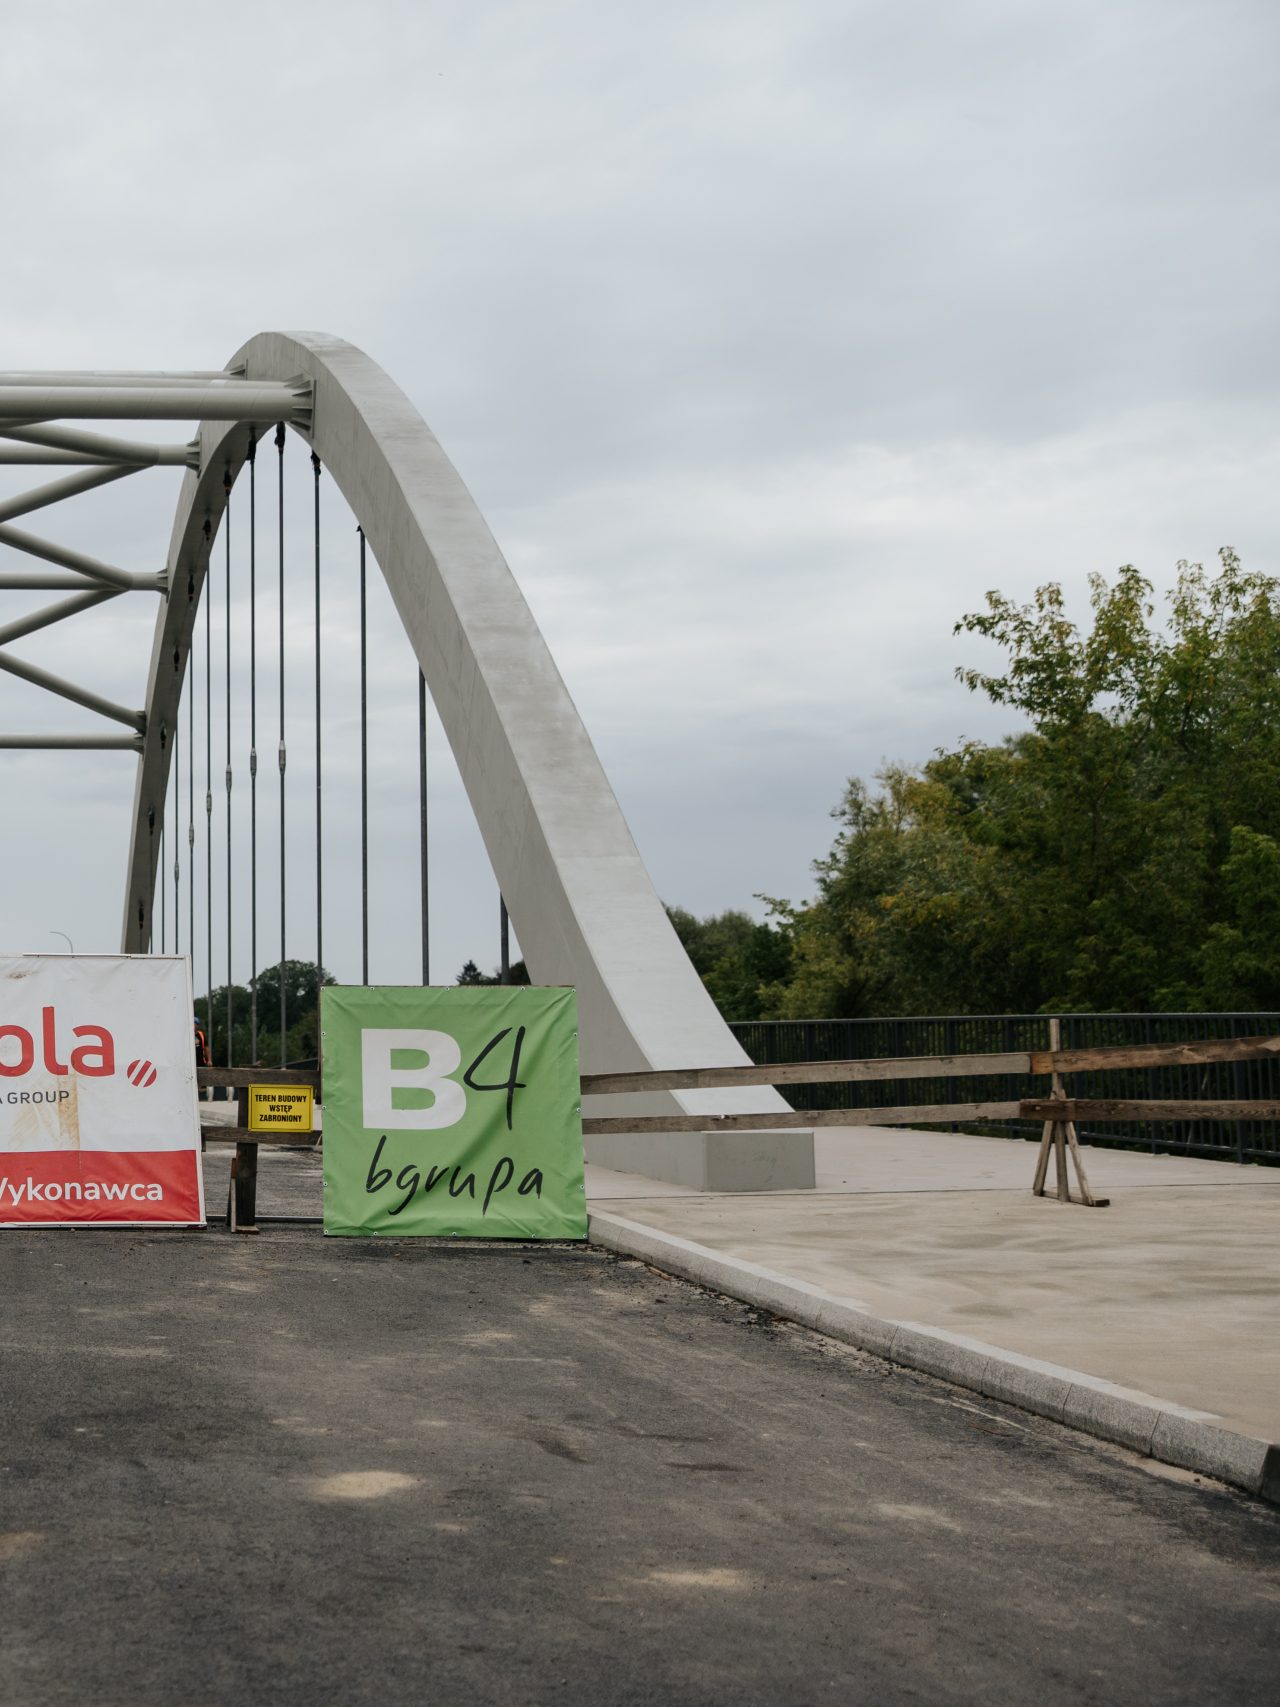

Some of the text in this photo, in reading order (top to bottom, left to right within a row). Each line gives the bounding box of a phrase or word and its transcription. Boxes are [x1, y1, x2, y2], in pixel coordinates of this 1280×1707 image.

[7, 1089, 70, 1105] GROUP
[255, 1095, 307, 1103] TEREN BUDOWY
[270, 1105, 292, 1114] WSTĘP
[259, 1114, 302, 1123] ZABRONIONY
[365, 1135, 543, 1216] bgrupa
